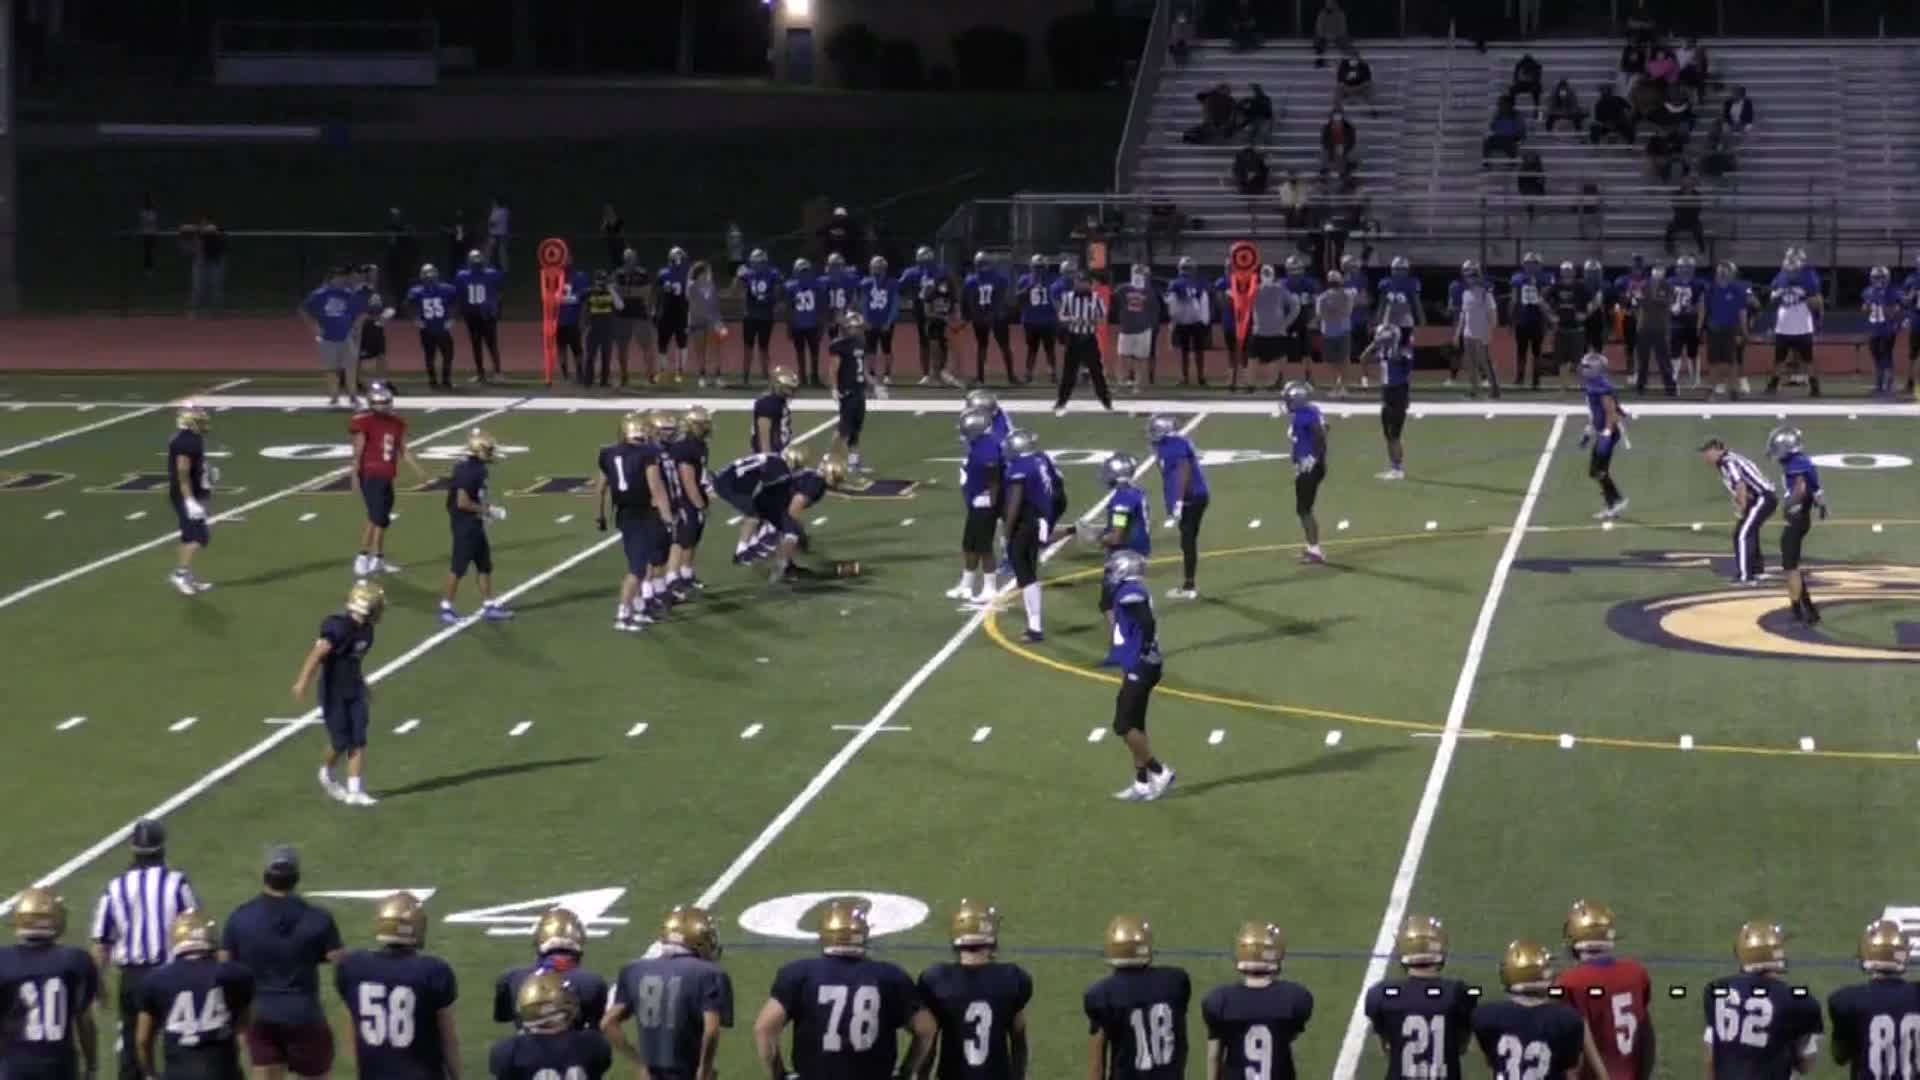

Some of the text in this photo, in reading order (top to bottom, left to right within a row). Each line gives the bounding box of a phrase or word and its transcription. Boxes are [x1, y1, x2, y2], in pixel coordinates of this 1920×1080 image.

[422, 297, 445, 319] 55
[614, 456, 628, 492] 1
[20, 977, 67, 1042] 10
[166, 987, 231, 1046] 44
[359, 982, 416, 1048] 58
[638, 976, 683, 1029] 81
[818, 985, 881, 1053] 78
[1610, 992, 1638, 1055] 5
[1714, 989, 1770, 1048] 62
[964, 1001, 993, 1066] 3
[1130, 1003, 1175, 1071] 18
[1244, 1025, 1273, 1080] 9
[1403, 1014, 1448, 1079] 21
[1498, 1035, 1551, 1080] 32
